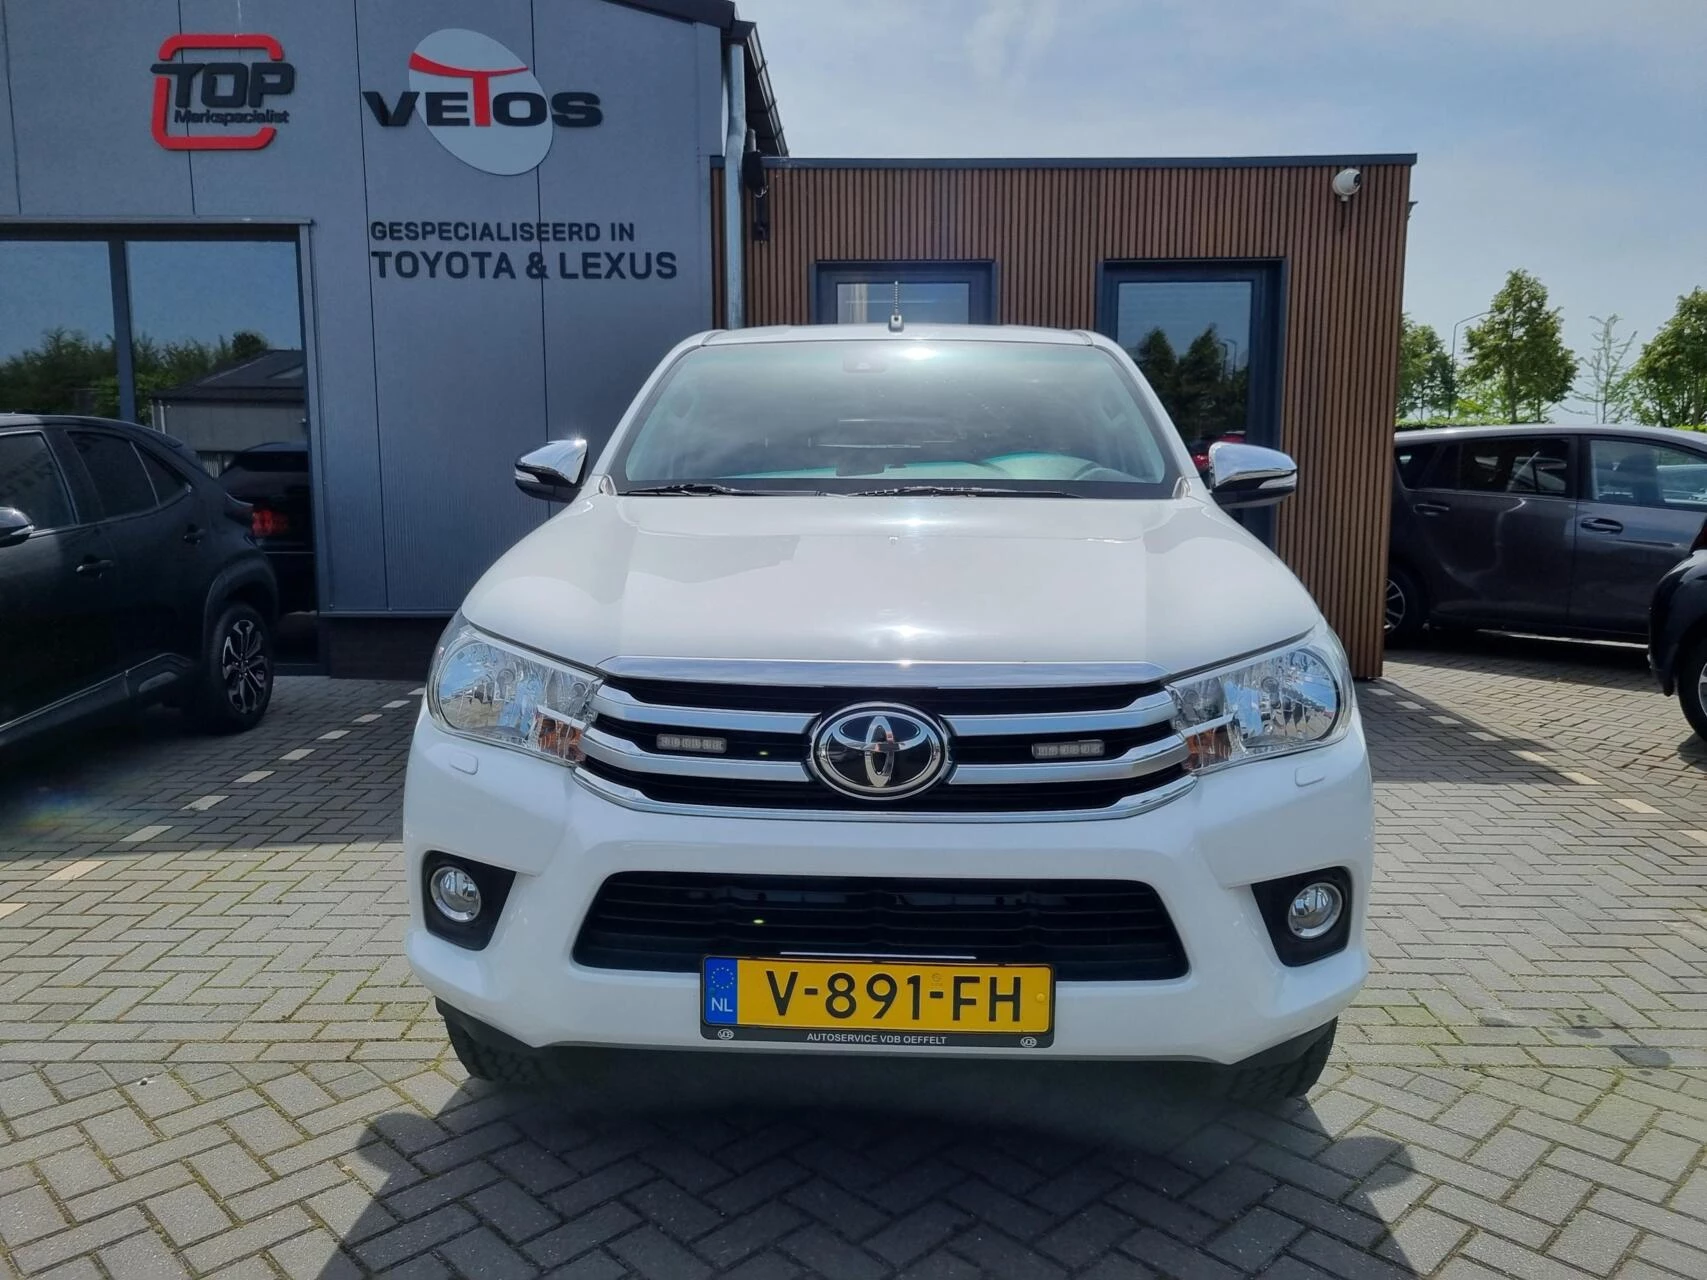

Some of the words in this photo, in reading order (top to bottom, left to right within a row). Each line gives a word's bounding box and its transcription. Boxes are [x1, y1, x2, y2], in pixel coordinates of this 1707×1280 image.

[150, 62, 296, 109] TOP
[361, 52, 604, 128] VETOS
[370, 221, 601, 242] GESPECIALISEERD
[610, 221, 635, 242] IN
[370, 250, 517, 280] TOYOTA
[525, 250, 550, 280] &
[559, 250, 678, 280] LEXUS
[710, 996, 734, 1013] NL
[765, 969, 1022, 1023] V-891-FH
[806, 1032, 878, 1044] AUTOSERVICE
[879, 1034, 901, 1044] VDB
[903, 1035, 947, 1045] OEFFELT
